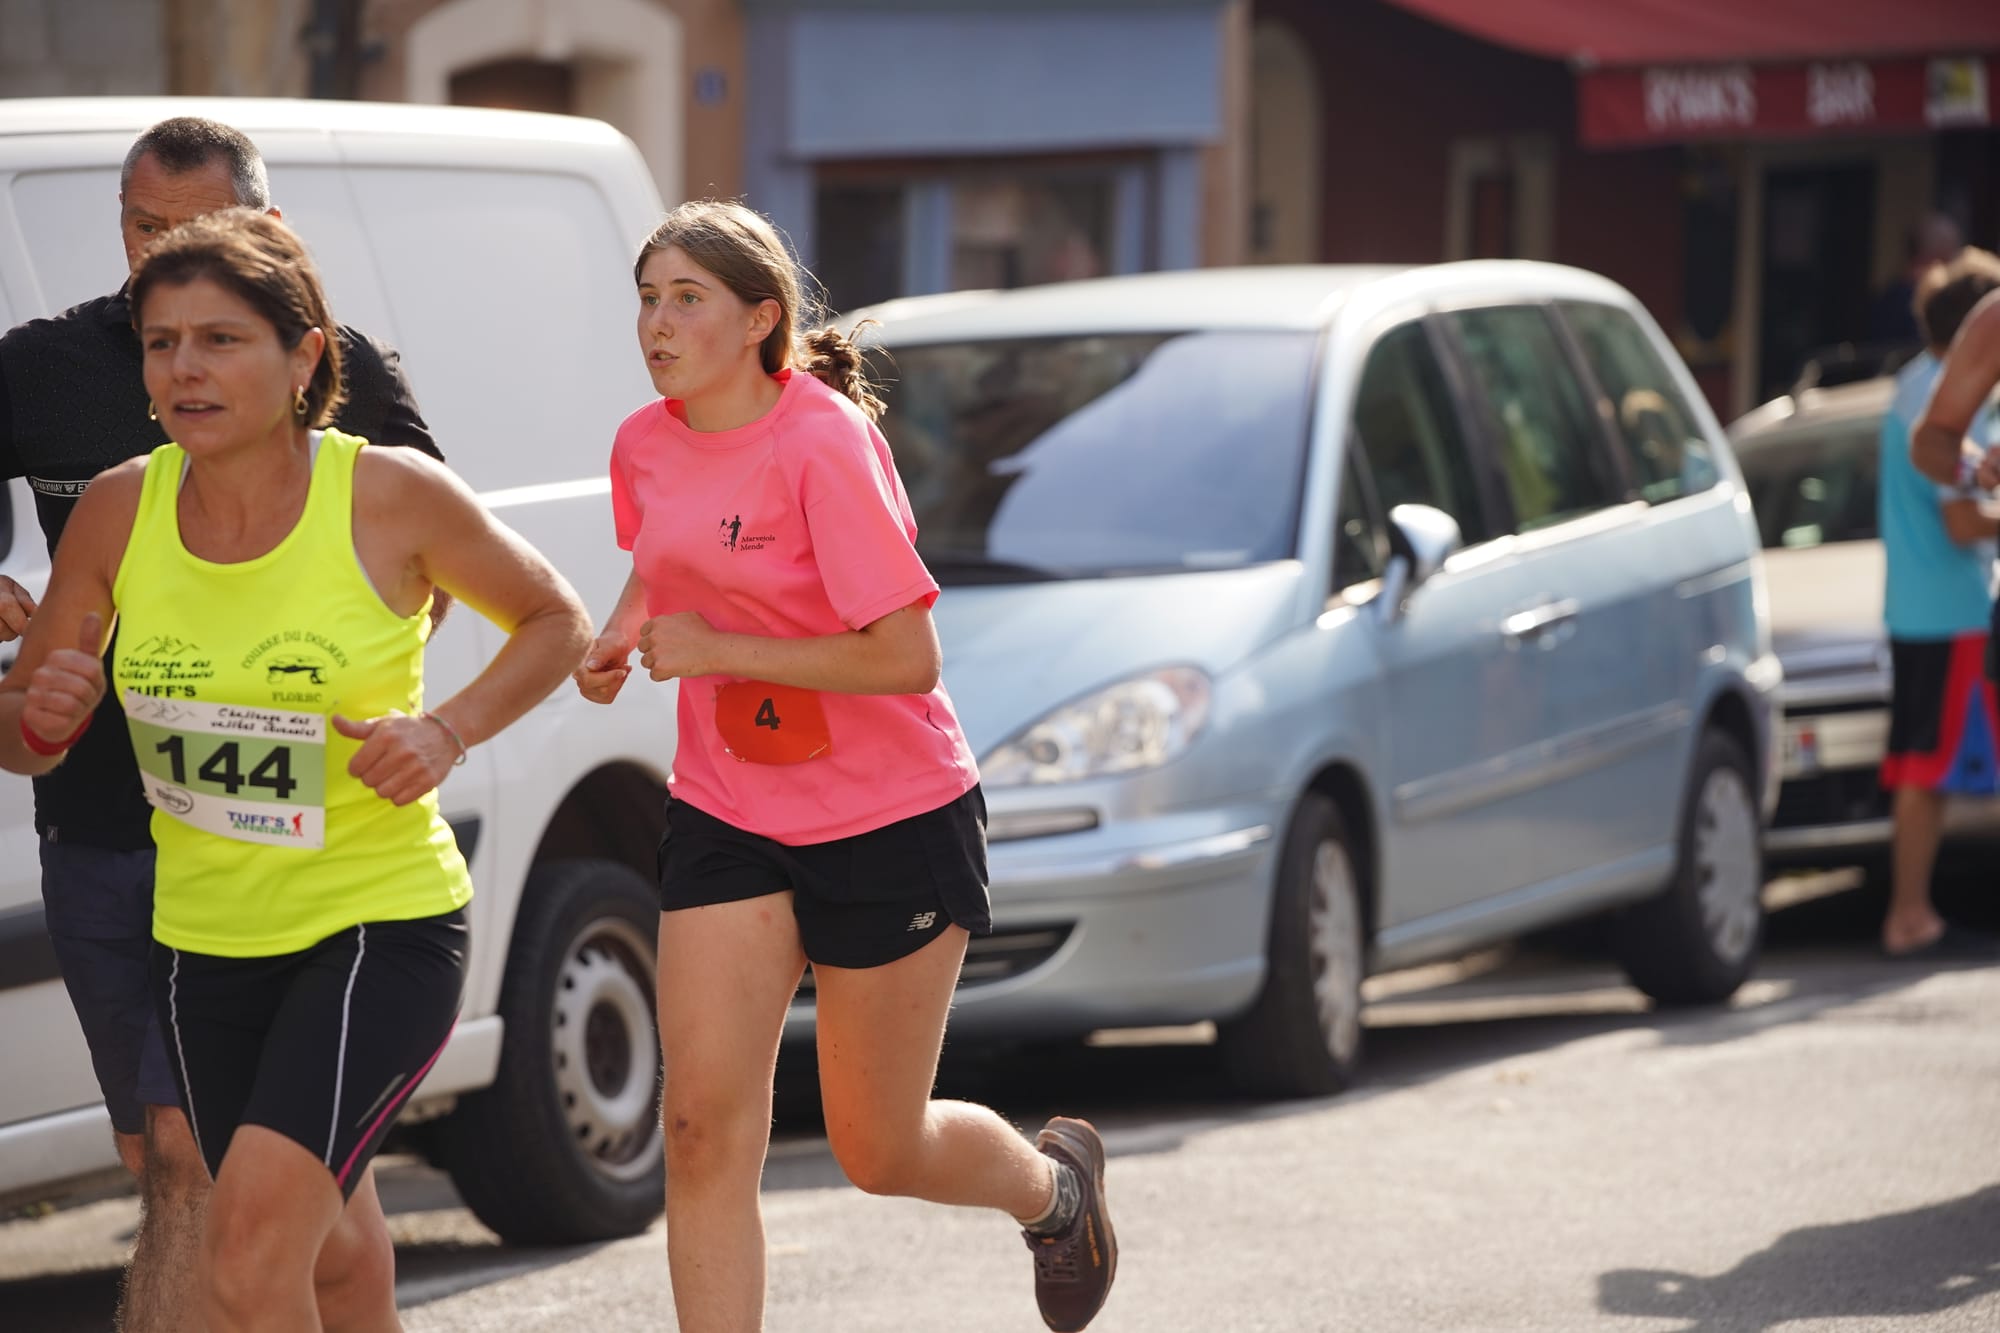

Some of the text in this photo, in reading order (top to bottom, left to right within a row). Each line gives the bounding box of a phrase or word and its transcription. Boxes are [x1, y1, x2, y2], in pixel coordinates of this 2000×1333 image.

[1806, 63, 1876, 124] BAR
[740, 543, 764, 551] Mende
[241, 631, 349, 669] COURSE DU DOLMEN
[218, 707, 311, 725] Challenge des
[755, 698, 781, 730] 4
[156, 735, 297, 799] 144
[226, 810, 285, 828] TUFF'S
